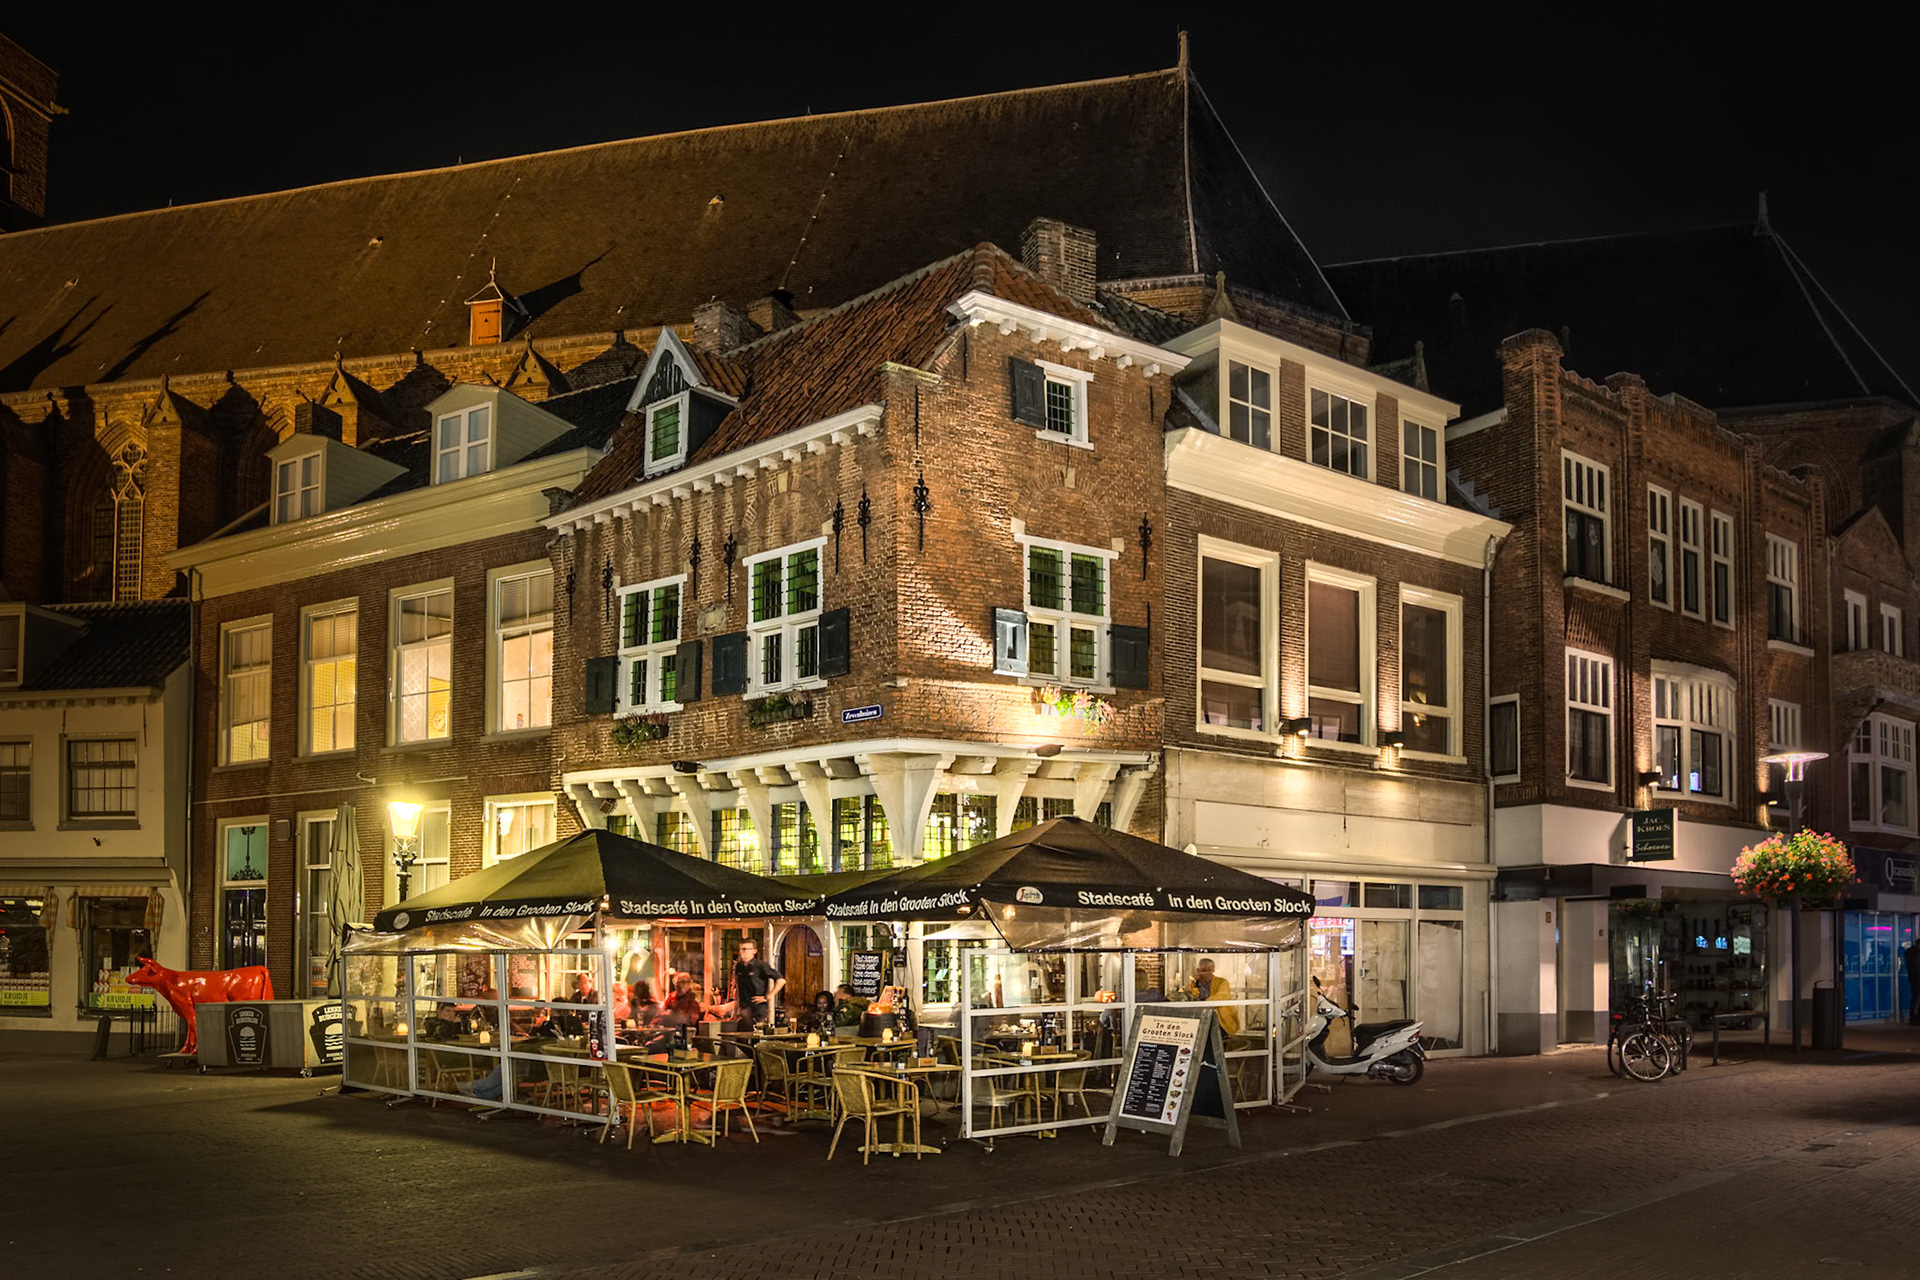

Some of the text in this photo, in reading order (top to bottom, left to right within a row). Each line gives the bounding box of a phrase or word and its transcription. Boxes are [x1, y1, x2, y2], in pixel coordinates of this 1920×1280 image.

[1637, 824, 1671, 832] KROES
[1635, 843, 1671, 852] Schoenen
[826, 889, 970, 916] Stadscafé In den Grooten Slock
[1078, 890, 1312, 914] Stadscafé In den Grooten Slock
[425, 906, 474, 923] Stadscafé
[479, 905, 494, 917] In
[494, 903, 515, 917] den
[516, 902, 561, 916] Grooten
[620, 900, 688, 915] Stadscafé
[691, 901, 705, 914] In
[707, 900, 732, 914] den
[734, 900, 783, 914] Grooten
[4, 992, 28, 1000] KRUIDJE
[106, 995, 132, 1003] KRUIDJE
[1167, 1023, 1181, 1031] den
[1142, 1028, 1194, 1039] Grooten Slock
